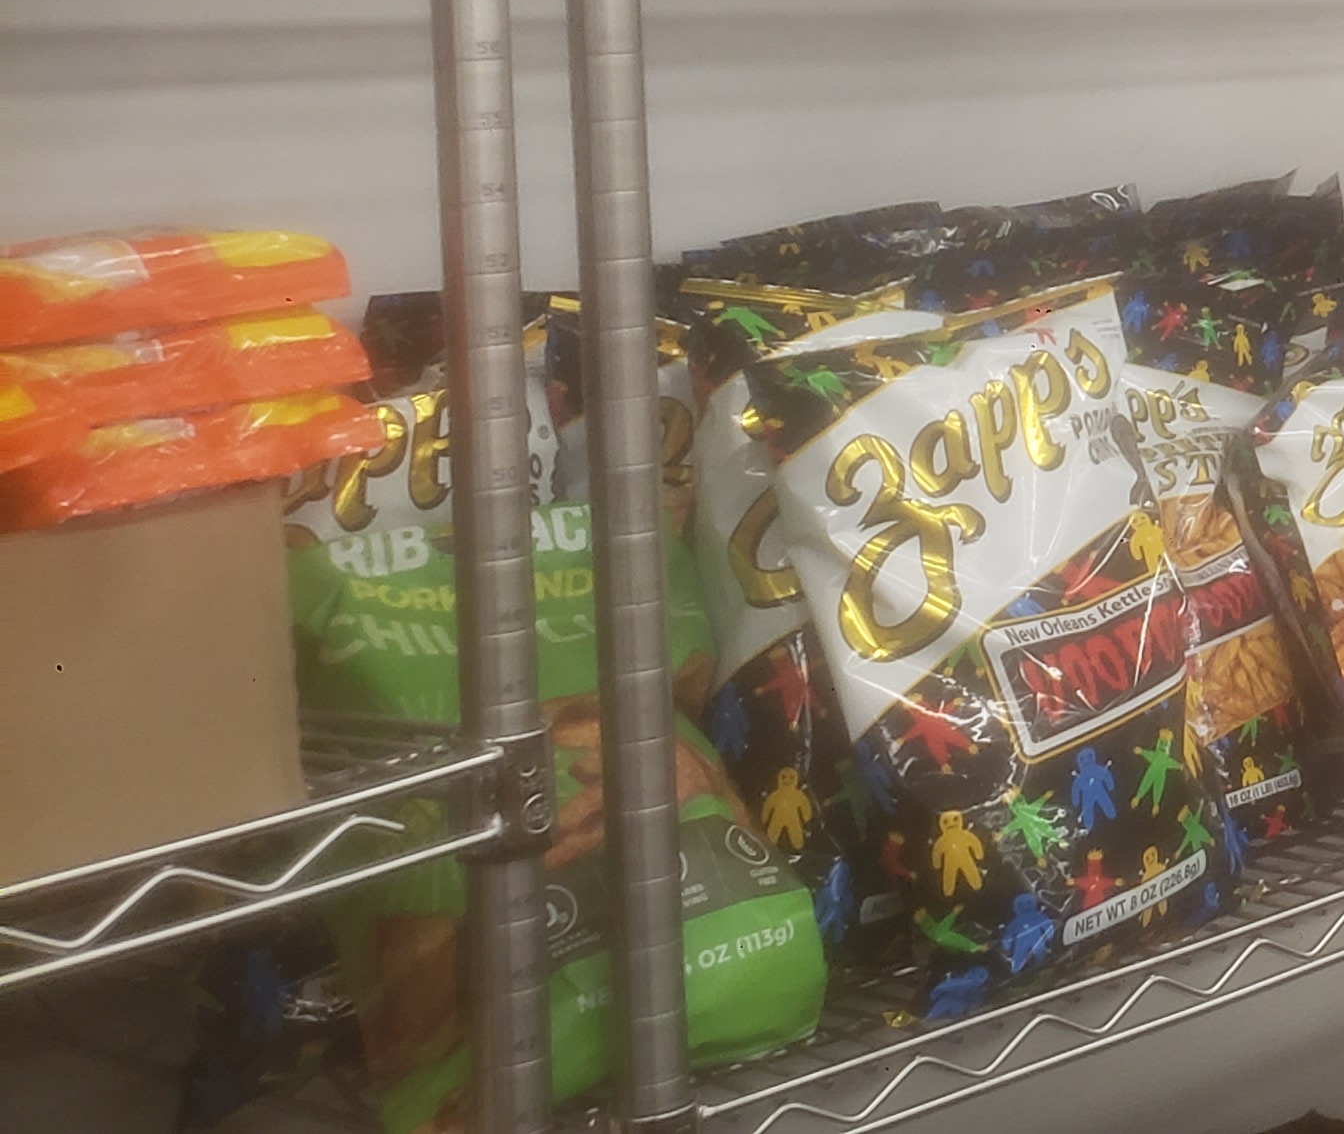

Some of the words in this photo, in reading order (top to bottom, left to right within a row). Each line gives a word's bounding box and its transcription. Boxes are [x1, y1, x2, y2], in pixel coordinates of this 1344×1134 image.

[1126, 379, 1211, 443] pp's
[825, 327, 1112, 664] Zapp's
[328, 525, 431, 578] RIB
[1005, 627, 1042, 647] New
[1043, 610, 1098, 638] Orleans
[1097, 588, 1151, 620] Kettle
[1240, 789, 1252, 803] OZ
[1074, 910, 1103, 938] NET
[1105, 899, 1126, 923] WT
[1140, 885, 1158, 905] OZ
[698, 943, 732, 968] OZ
[736, 919, 796, 959] (113g)
